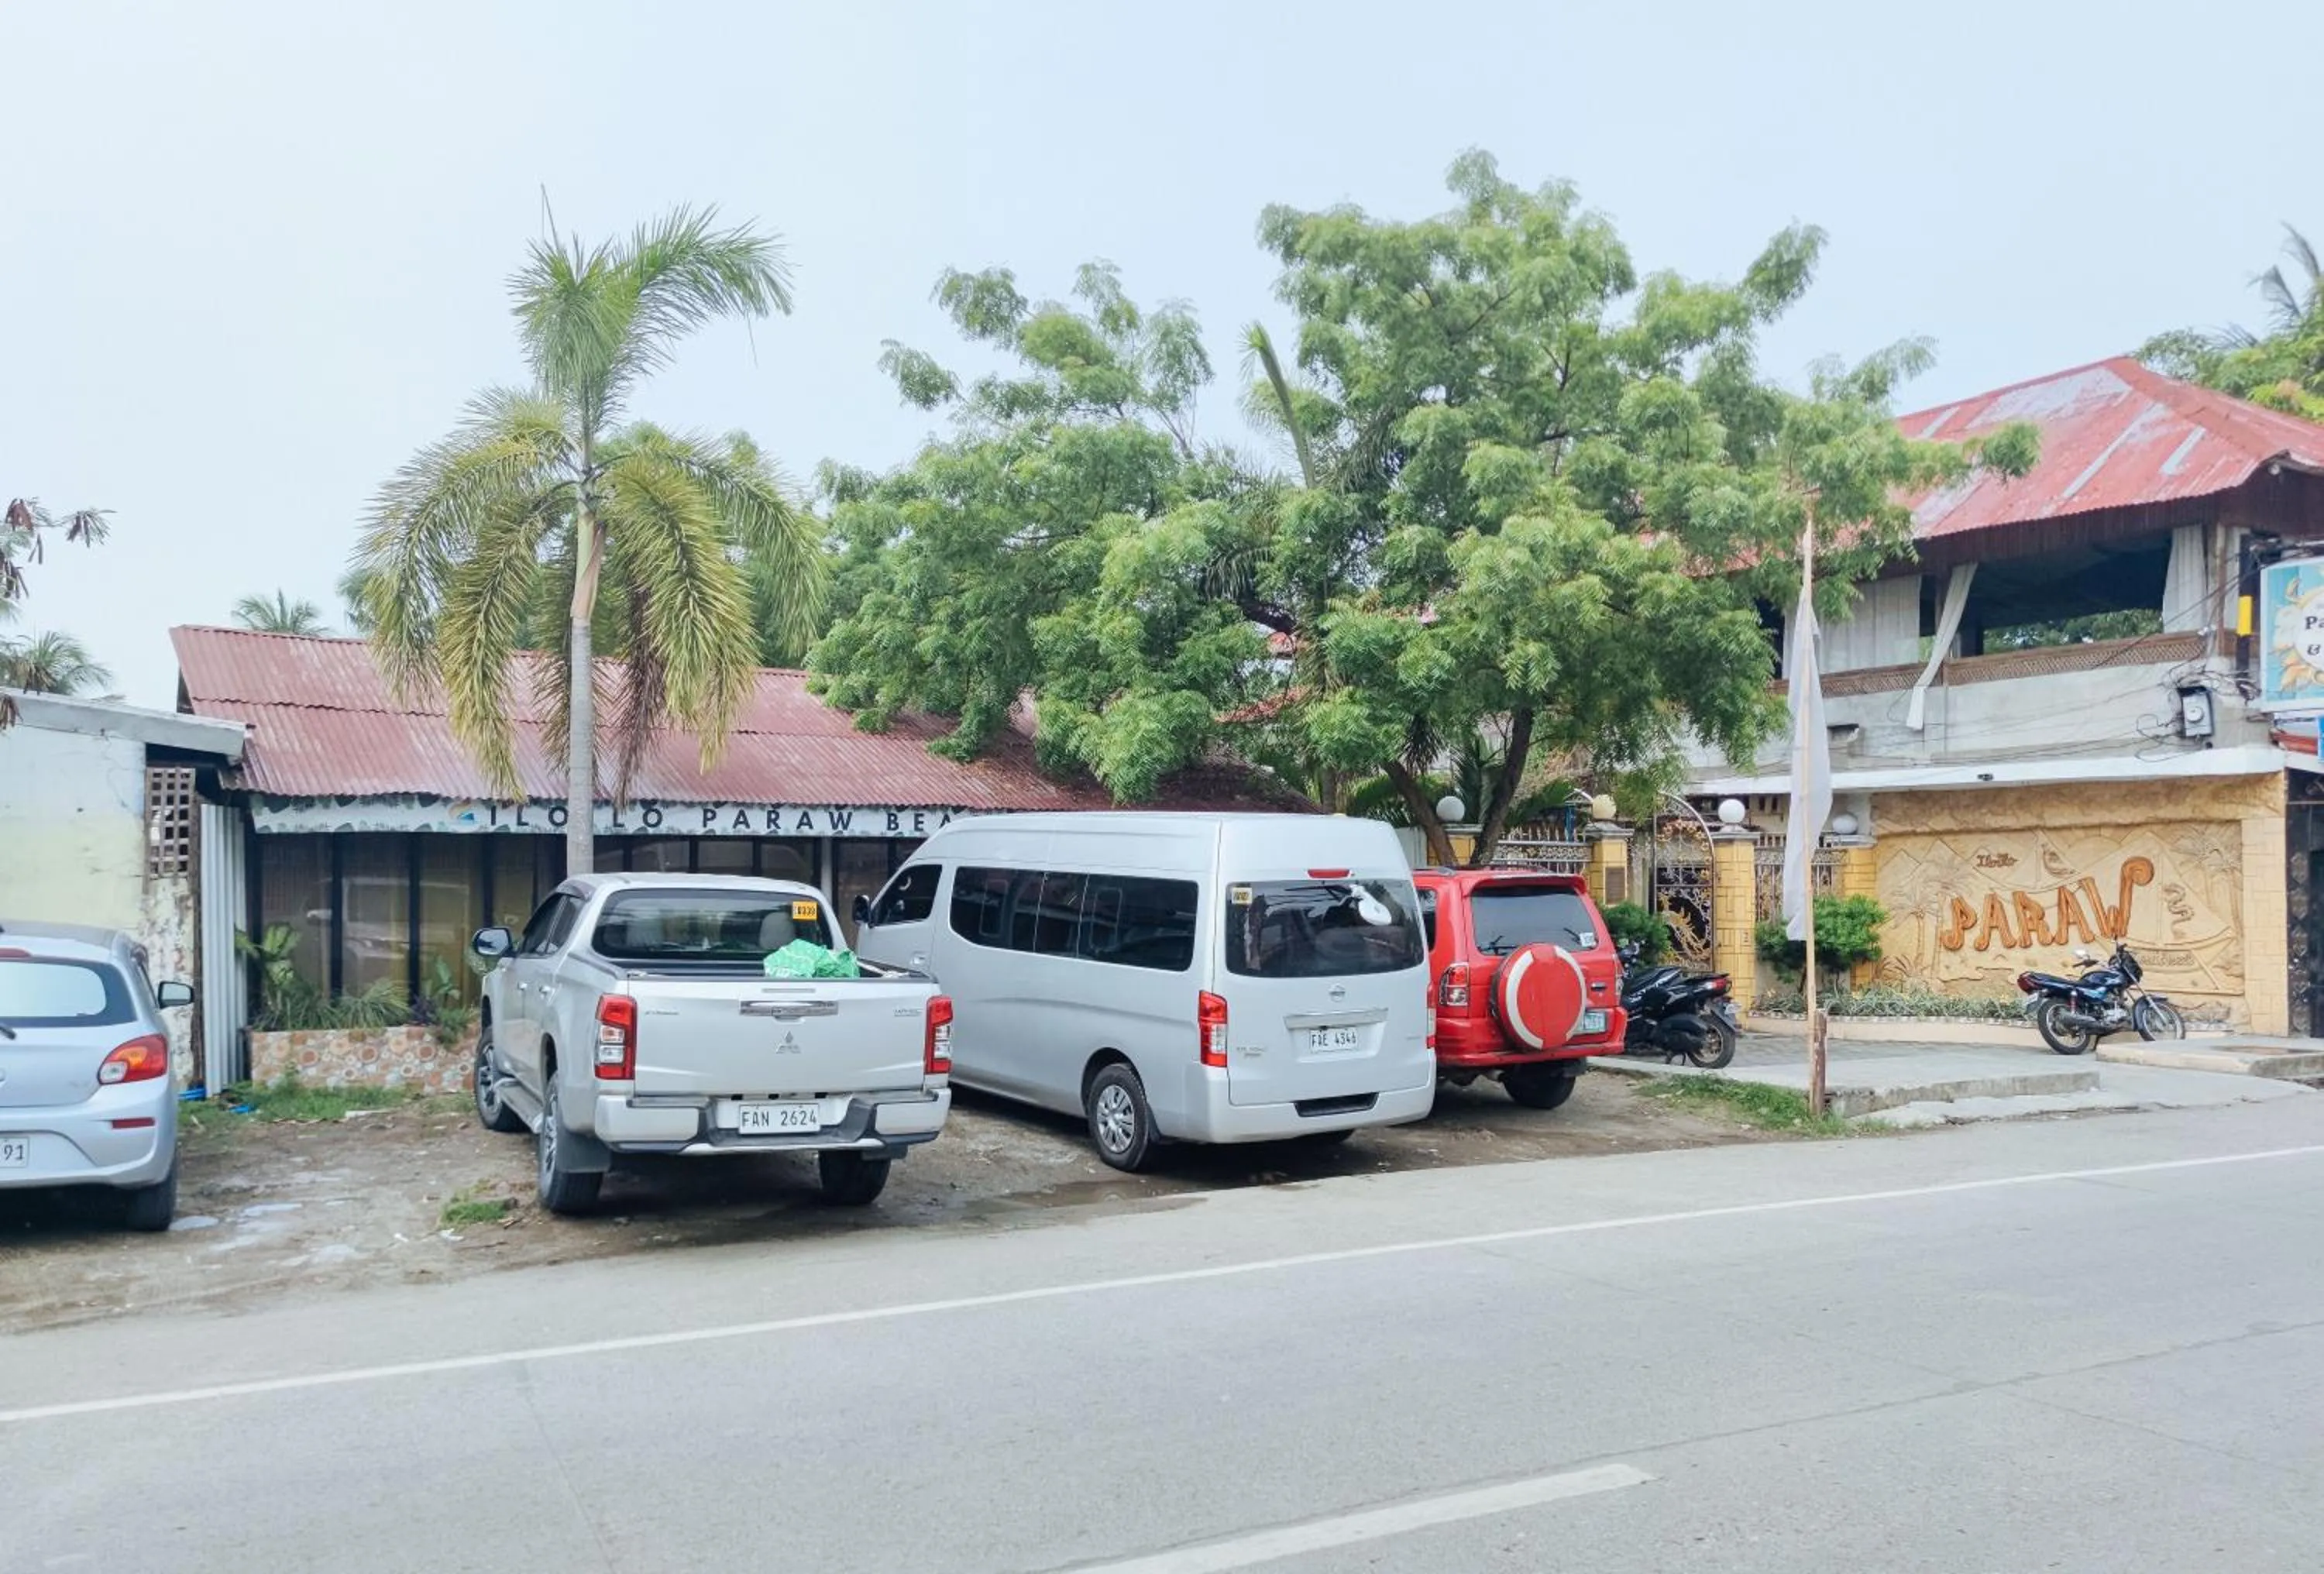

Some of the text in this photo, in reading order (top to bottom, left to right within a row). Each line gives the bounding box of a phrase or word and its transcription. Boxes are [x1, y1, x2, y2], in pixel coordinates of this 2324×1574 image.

[490, 804, 662, 828] ILOLO
[702, 809, 853, 831] PARAW
[1939, 856, 2154, 951] PARAW
[741, 1109, 816, 1126] FAN 2624
[4, 1144, 24, 1160] 91
